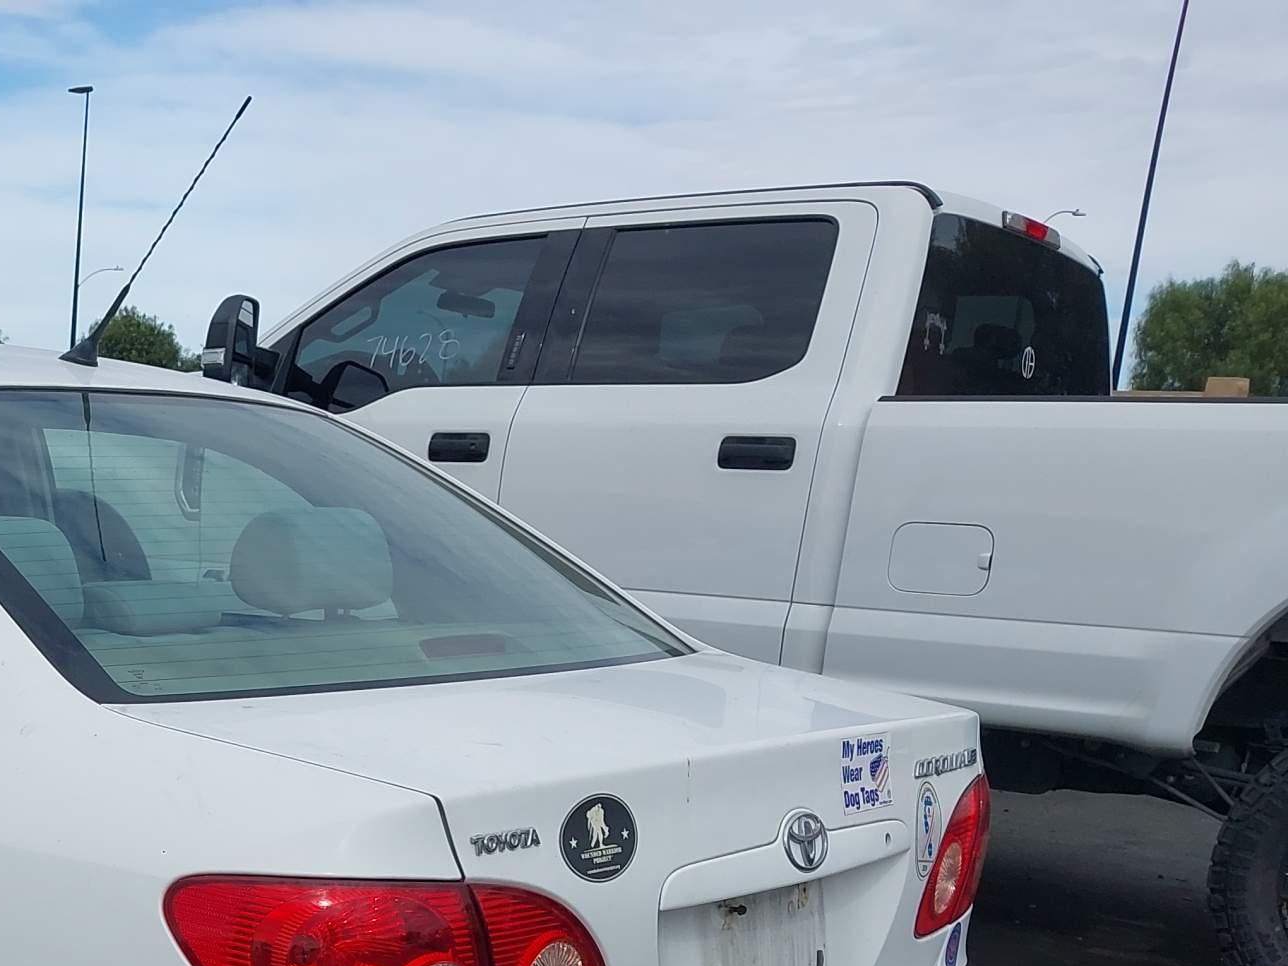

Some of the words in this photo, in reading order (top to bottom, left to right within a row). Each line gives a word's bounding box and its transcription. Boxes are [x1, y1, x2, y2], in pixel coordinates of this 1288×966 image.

[841, 740, 855, 762] My
[856, 738, 884, 757] Heroes
[841, 765, 863, 784] Wear
[843, 790, 861, 810] Dog
[860, 786, 880, 807] Tags
[469, 827, 541, 857] TOYOTA
